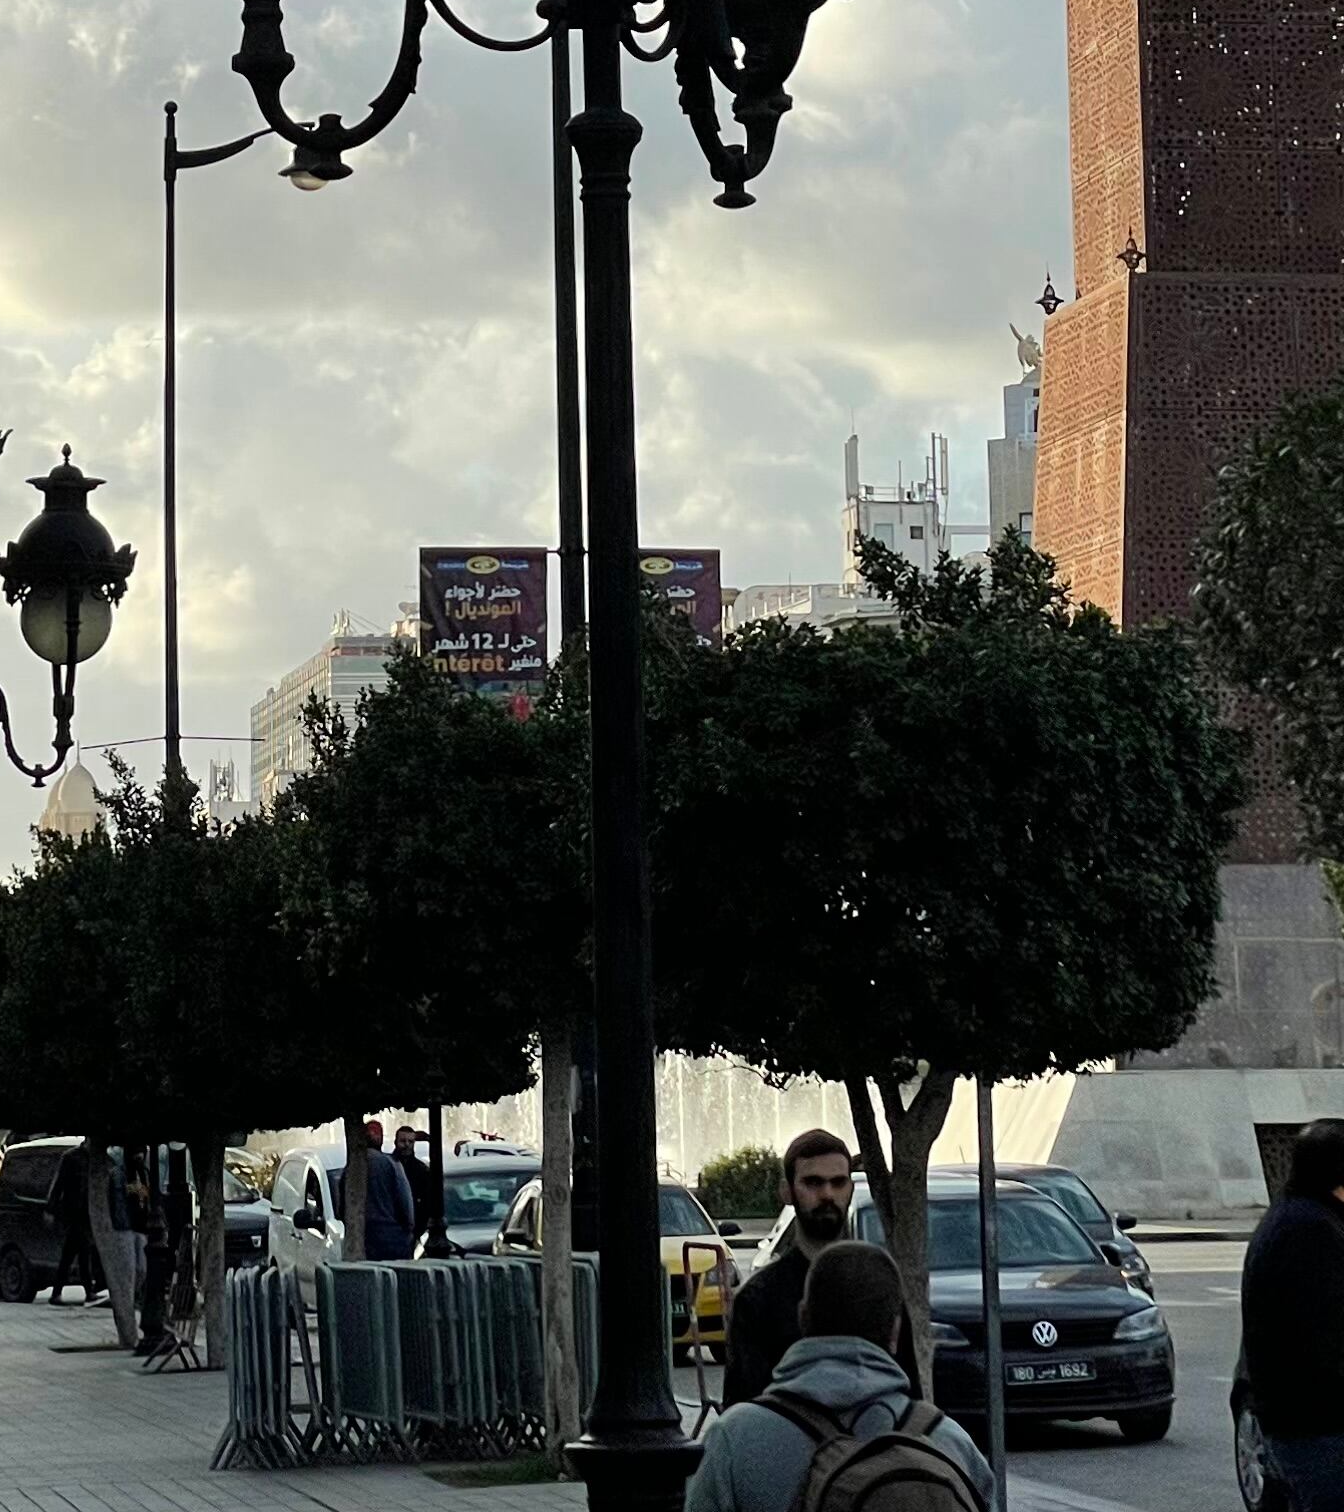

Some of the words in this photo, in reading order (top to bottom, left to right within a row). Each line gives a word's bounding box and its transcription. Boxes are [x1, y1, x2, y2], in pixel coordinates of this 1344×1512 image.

[431, 632, 469, 654] شهر
[471, 632, 494, 649] 12
[432, 653, 505, 672] ntérêt
[1059, 1363, 1088, 1377] 1692
